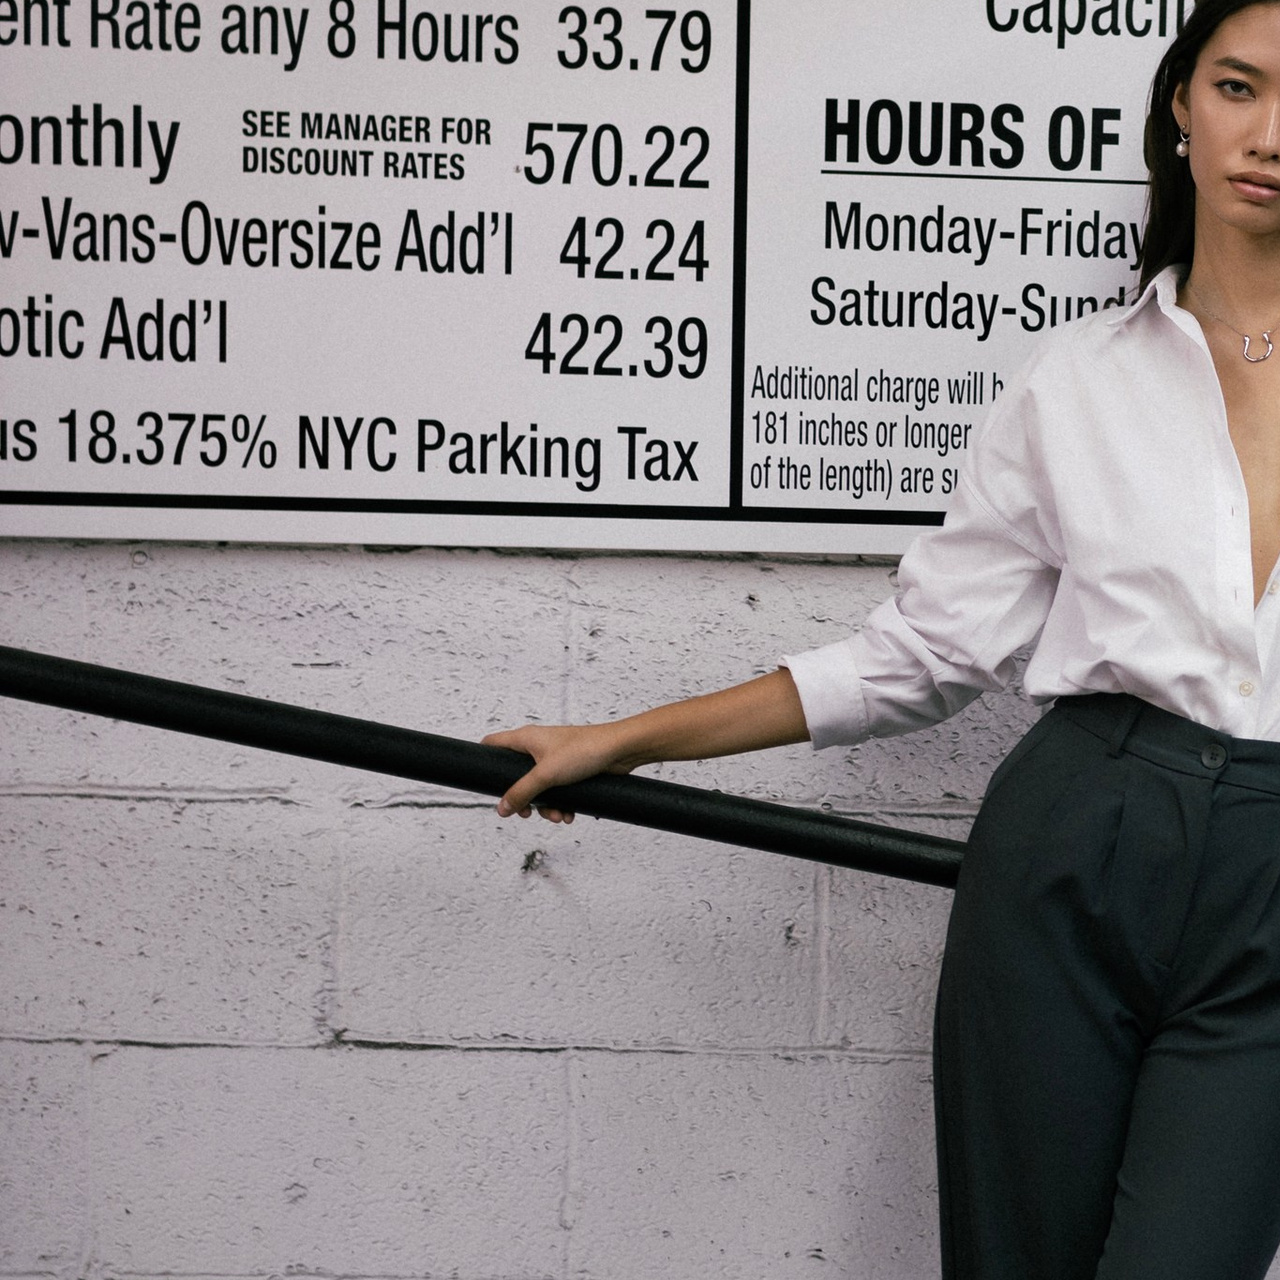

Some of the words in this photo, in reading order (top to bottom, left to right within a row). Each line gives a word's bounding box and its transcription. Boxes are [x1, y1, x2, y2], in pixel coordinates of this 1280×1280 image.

[221, 4, 309, 72] any
[557, 5, 711, 74] 33.79
[242, 110, 290, 138] SEE
[301, 112, 430, 143] MANAGER
[442, 117, 491, 145] FOR
[524, 122, 710, 189] 570.22
[824, 98, 1024, 169] HOURS
[1048, 105, 1121, 171] OF
[243, 146, 374, 177] DISCOUNT
[384, 151, 465, 180] RATES
[395, 209, 512, 275] Add'l
[560, 216, 709, 282] 42.24
[100, 297, 227, 363] Add'l
[525, 312, 708, 379] 422.39
[751, 365, 859, 402] Additional
[866, 368, 940, 412] charge
[947, 370, 984, 405] will
[59, 409, 277, 469] 18.375%
[299, 415, 397, 472] NYC
[418, 419, 601, 492] Parking
[617, 426, 698, 481] Tax
[752, 410, 787, 445] 181
[799, 411, 868, 447] inches
[875, 421, 898, 448] or
[904, 414, 972, 457] longer
